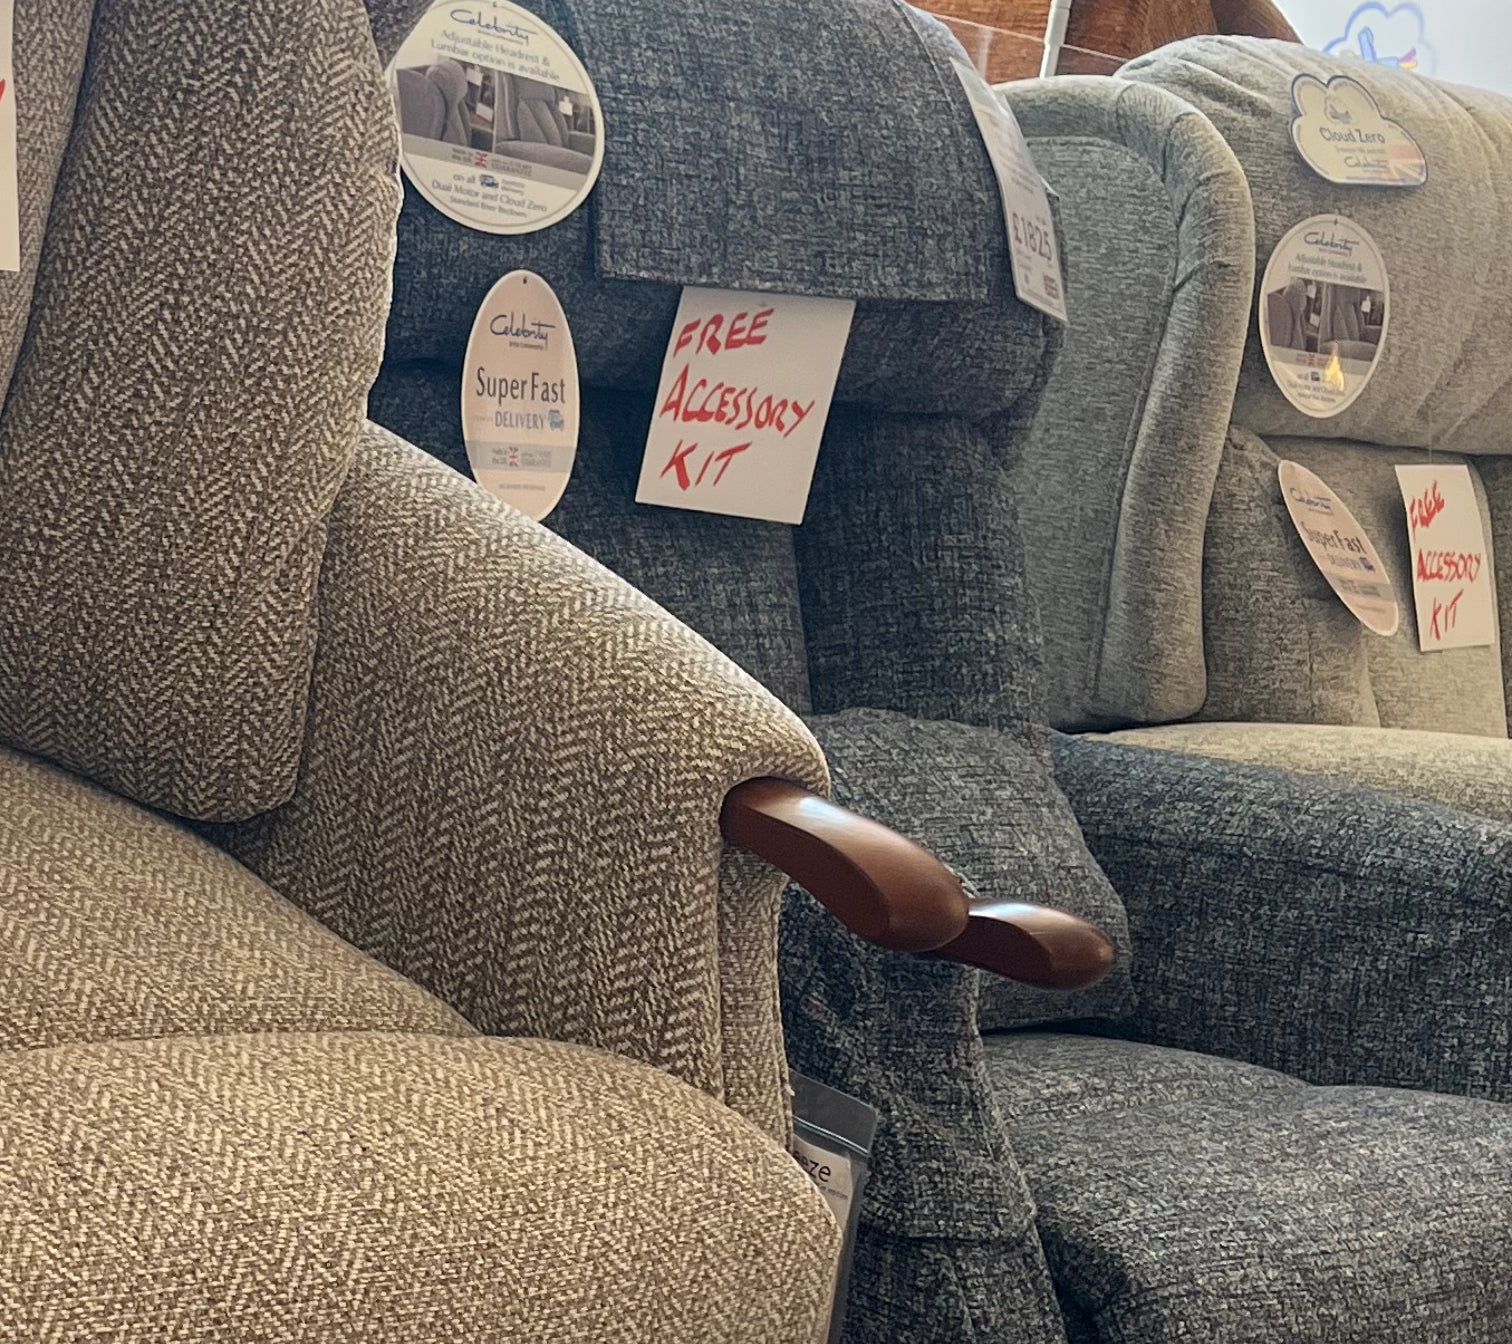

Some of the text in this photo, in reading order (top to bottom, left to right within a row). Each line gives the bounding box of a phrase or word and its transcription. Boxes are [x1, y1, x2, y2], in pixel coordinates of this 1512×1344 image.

[441, 29, 493, 51] Adjustable
[494, 42, 539, 64] Headrest
[450, 9, 537, 47] Celebrity
[430, 38, 469, 58] Lumbar
[472, 50, 506, 67] option
[518, 61, 560, 81] available
[1319, 127, 1385, 144] Cloud Zero
[431, 179, 547, 212] Dual Motor and Cloud Zero
[1012, 212, 1052, 261] £1825
[1303, 231, 1360, 256] Celebrity
[490, 312, 556, 350] Celebrity
[674, 309, 774, 359] FREE
[495, 411, 544, 429] DELIVERY
[660, 363, 815, 439] ACCESSORY
[660, 440, 752, 491] KIT
[1410, 480, 1445, 543] FREE
[1417, 549, 1481, 583] ACCESSORY
[1430, 589, 1464, 641] KIT
